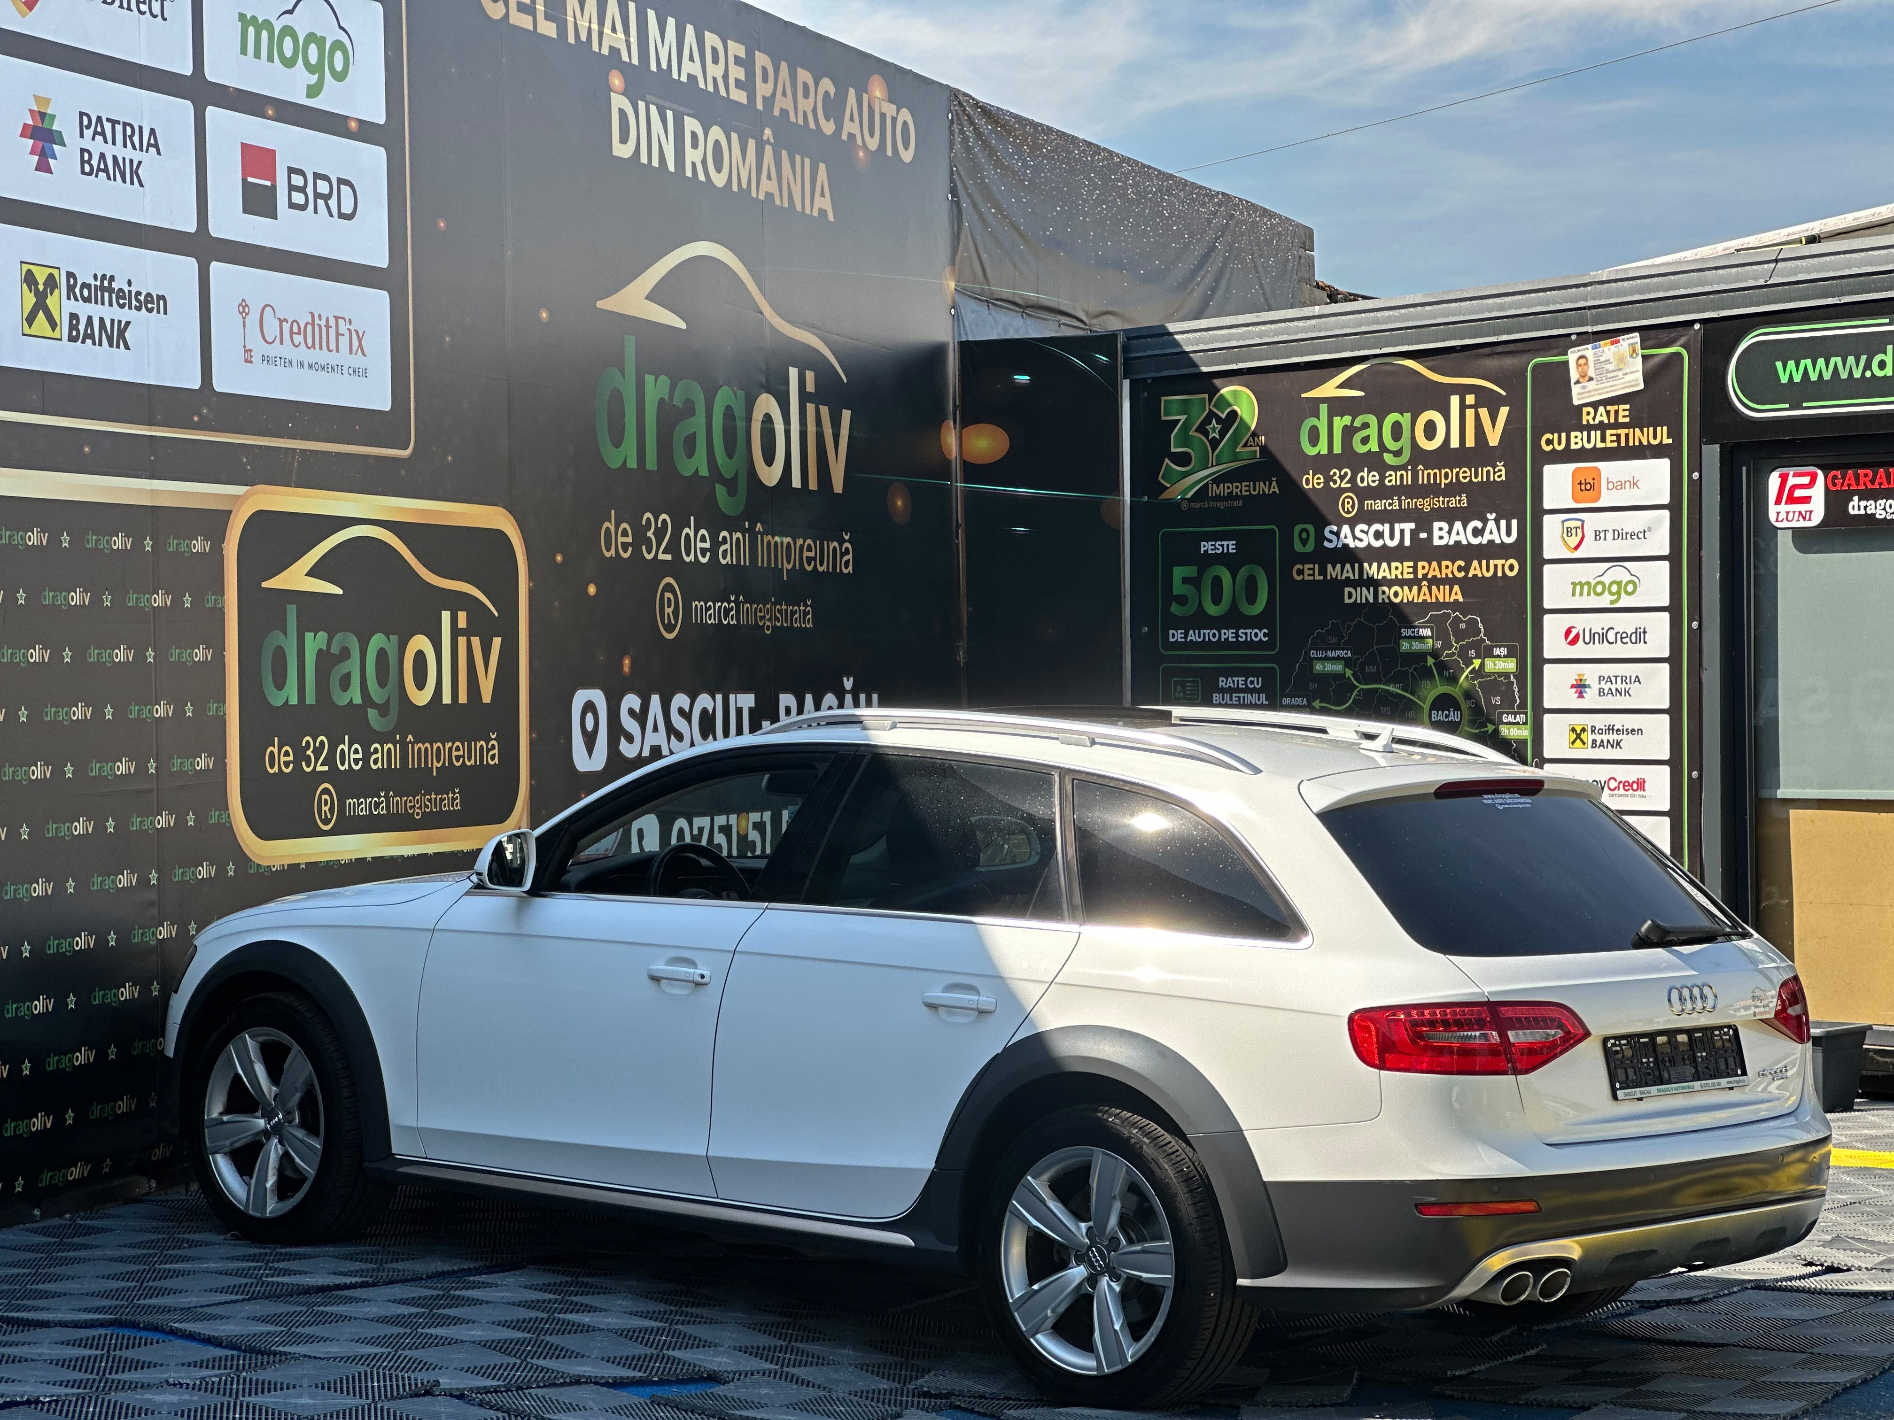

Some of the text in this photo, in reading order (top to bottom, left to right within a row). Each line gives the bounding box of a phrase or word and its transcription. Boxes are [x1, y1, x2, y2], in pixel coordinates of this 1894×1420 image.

[237, 11, 351, 99] mogo
[566, 0, 639, 65] MAI
[647, 8, 748, 105] MARE
[754, 50, 836, 137] PARC
[841, 87, 916, 164] AUTO
[78, 111, 162, 156] PATRIA
[79, 147, 145, 188] BANK
[610, 91, 835, 222] DIN ROMÂNIA
[287, 166, 358, 221] BRD
[65, 270, 168, 316] Raiffeisen
[67, 312, 131, 351] BANK
[259, 303, 367, 357] CreditFix
[261, 354, 368, 379] PRIETEN IN MOMENTE CHEIE
[595, 334, 852, 517] dragoliv
[1582, 404, 1630, 425] RATE
[1158, 385, 1265, 488] 32 ANI
[1300, 394, 1510, 466] dragoliv
[1541, 426, 1672, 451] CU BULETINUL
[1208, 477, 1279, 497] ÎMPREUNĂ
[1302, 462, 1506, 489] de 32 de ani împreună
[1577, 477, 1596, 492] tbi
[1606, 476, 1640, 491] bank
[1774, 471, 1818, 506] 12
[1364, 495, 1399, 511] marcă
[1401, 493, 1468, 512] înregistrată
[1774, 510, 1813, 523] LUNI
[0, 526, 48, 549] dragoliv
[85, 531, 132, 553] dragoliv
[1323, 522, 1415, 548] SASCUT
[1433, 513, 1518, 546] BACĂU
[1566, 526, 1580, 538] BT
[1593, 529, 1610, 542] BT
[167, 535, 210, 556] dragoliv
[600, 509, 853, 580] de 32 de ani împreună
[1200, 541, 1236, 553] PESTE
[1292, 558, 1519, 581] CEL MAI MARE PARC AUTO
[41, 587, 91, 609] dragoliv
[126, 589, 172, 610] dragoliv
[1169, 564, 1269, 617] 500
[1344, 581, 1464, 604] DIN ROMÂNIA
[1571, 579, 1638, 605] mogo
[692, 594, 737, 625] marcă
[739, 595, 813, 634] înregistrată
[1169, 629, 1269, 642] DE AUTO PE STOC
[1400, 628, 1432, 637] SUCEAVA
[1582, 626, 1648, 646] UniCredit
[0, 645, 50, 667] dragoliv
[86, 644, 134, 666] dragoliv
[168, 645, 212, 665] dragoliv
[1310, 650, 1352, 658] CLUJ-NAPOCA
[1402, 641, 1409, 650] 2h
[1411, 641, 1431, 650] 30min
[261, 604, 502, 732] dragoliv
[1324, 663, 1343, 671] 30min
[1486, 661, 1515, 669] 1h 30min
[1218, 676, 1262, 689] RATE CU
[1597, 674, 1642, 687] PATRIA
[1212, 693, 1269, 705] BULETINUL
[1282, 697, 1307, 706] ORADEA
[1491, 696, 1501, 705] VS
[1598, 687, 1632, 698] BANK
[43, 702, 92, 725] dragoliv
[128, 700, 173, 722] dragoliv
[619, 692, 755, 759] SASCUT
[1501, 728, 1509, 736] 2h
[1590, 724, 1643, 736] Raiffeisen
[265, 732, 499, 776] de 32 de ani împreună
[1591, 738, 1624, 749] BANK
[1, 761, 52, 784] dragoliv
[88, 757, 135, 779] dragoliv
[170, 753, 214, 774] dragoliv
[346, 791, 386, 817] marcă
[389, 787, 461, 819] înregistrată
[45, 817, 94, 840] dragoliv
[129, 810, 175, 833] dragoliv
[90, 870, 137, 893] dragoliv
[172, 861, 216, 884] dragoliv
[2, 878, 53, 901] dragoliv
[46, 931, 95, 956] dragoliv
[131, 921, 177, 945] dragoliv
[91, 982, 139, 1006] dragoliv
[4, 995, 54, 1020] dragoliv
[131, 1037, 164, 1057] drago
[46, 1046, 95, 1072] dragoliv
[3, 1112, 53, 1137] dragoliv
[38, 1161, 92, 1187] dragoliv
